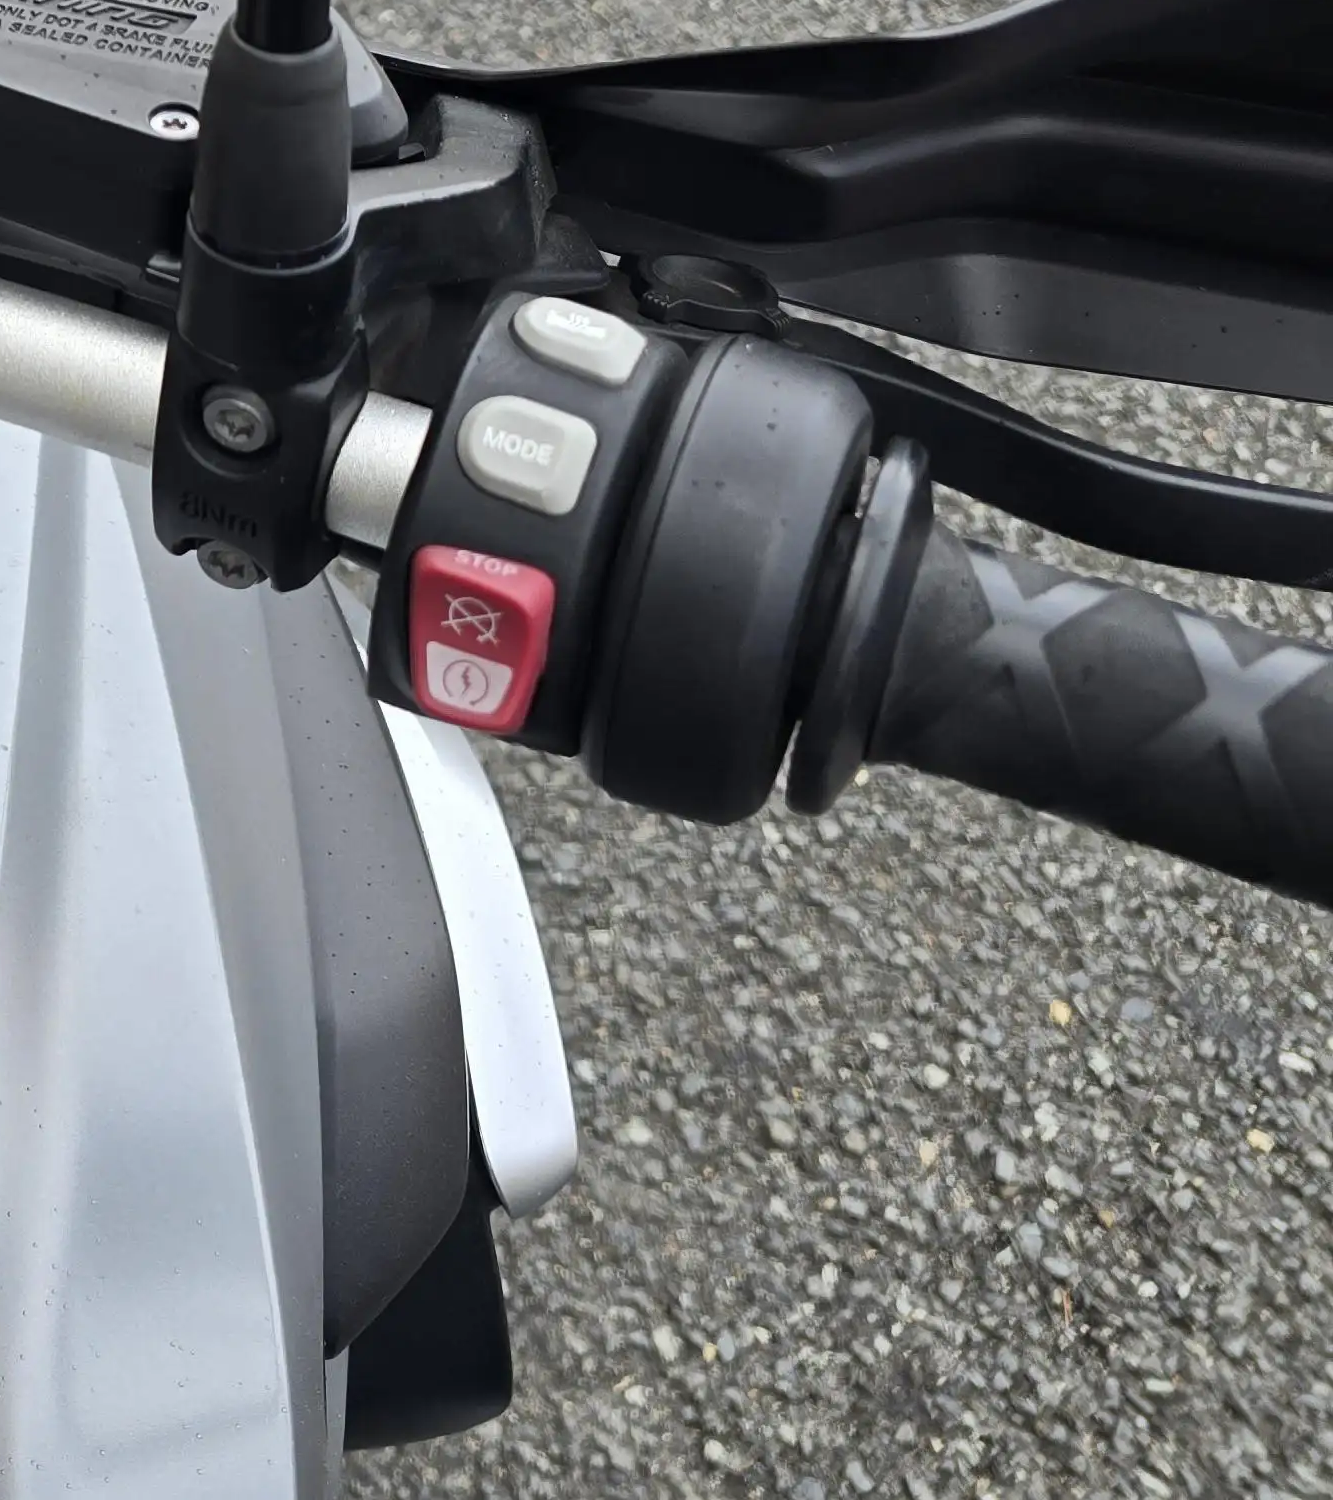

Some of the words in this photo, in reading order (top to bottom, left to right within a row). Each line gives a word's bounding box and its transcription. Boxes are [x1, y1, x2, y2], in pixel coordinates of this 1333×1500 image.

[8, 21, 89, 45] SEALED
[43, 13, 84, 30] DOT
[100, 24, 168, 46] BRAKE
[169, 37, 215, 53] FLUI
[483, 426, 555, 467] MODE
[454, 549, 520, 577] STOP
